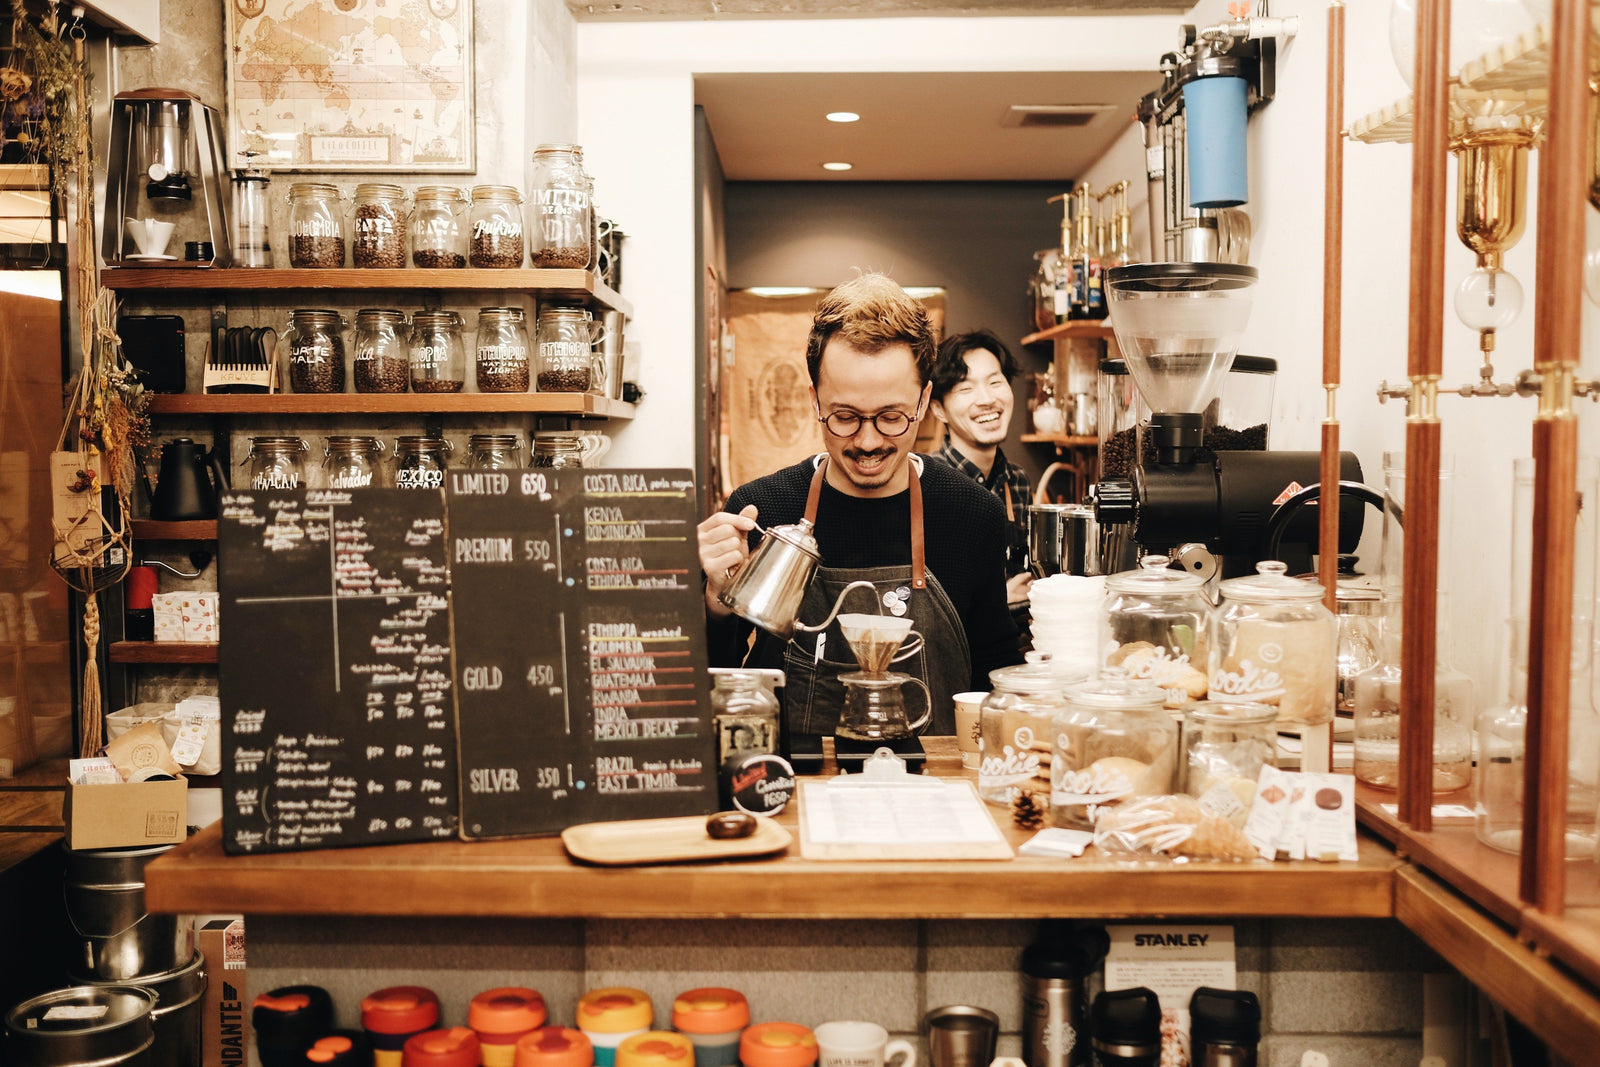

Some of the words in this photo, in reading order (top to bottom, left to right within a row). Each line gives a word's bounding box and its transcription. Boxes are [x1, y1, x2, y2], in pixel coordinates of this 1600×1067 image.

[453, 473, 509, 495] LIMITED
[521, 473, 547, 495] 650
[584, 474, 622, 493] COSTA
[622, 474, 649, 492] RICA
[584, 507, 624, 522] KENYA
[586, 523, 646, 539] DOMINICAN
[455, 538, 513, 563] PREMIUM
[525, 540, 550, 561] 550
[586, 557, 619, 572] COSTA
[621, 557, 645, 571] RICA
[588, 574, 634, 589] ETHIOPIA
[588, 623, 637, 639] ETHIOPIA
[591, 656, 606, 671] EL
[463, 666, 503, 691] GOLD
[526, 665, 554, 686] 450
[592, 672, 656, 688] GUATEMALA
[593, 689, 642, 705] RWANDA
[594, 706, 629, 722] INDIA
[594, 723, 638, 740] MEXICO
[642, 720, 679, 738] DECAF
[596, 757, 637, 775] BRAZIL
[470, 768, 520, 793] SILVER
[536, 767, 560, 788] 350
[597, 773, 630, 792] EAST
[635, 772, 678, 790] TIMOR
[1134, 933, 1209, 947] STANLEY
